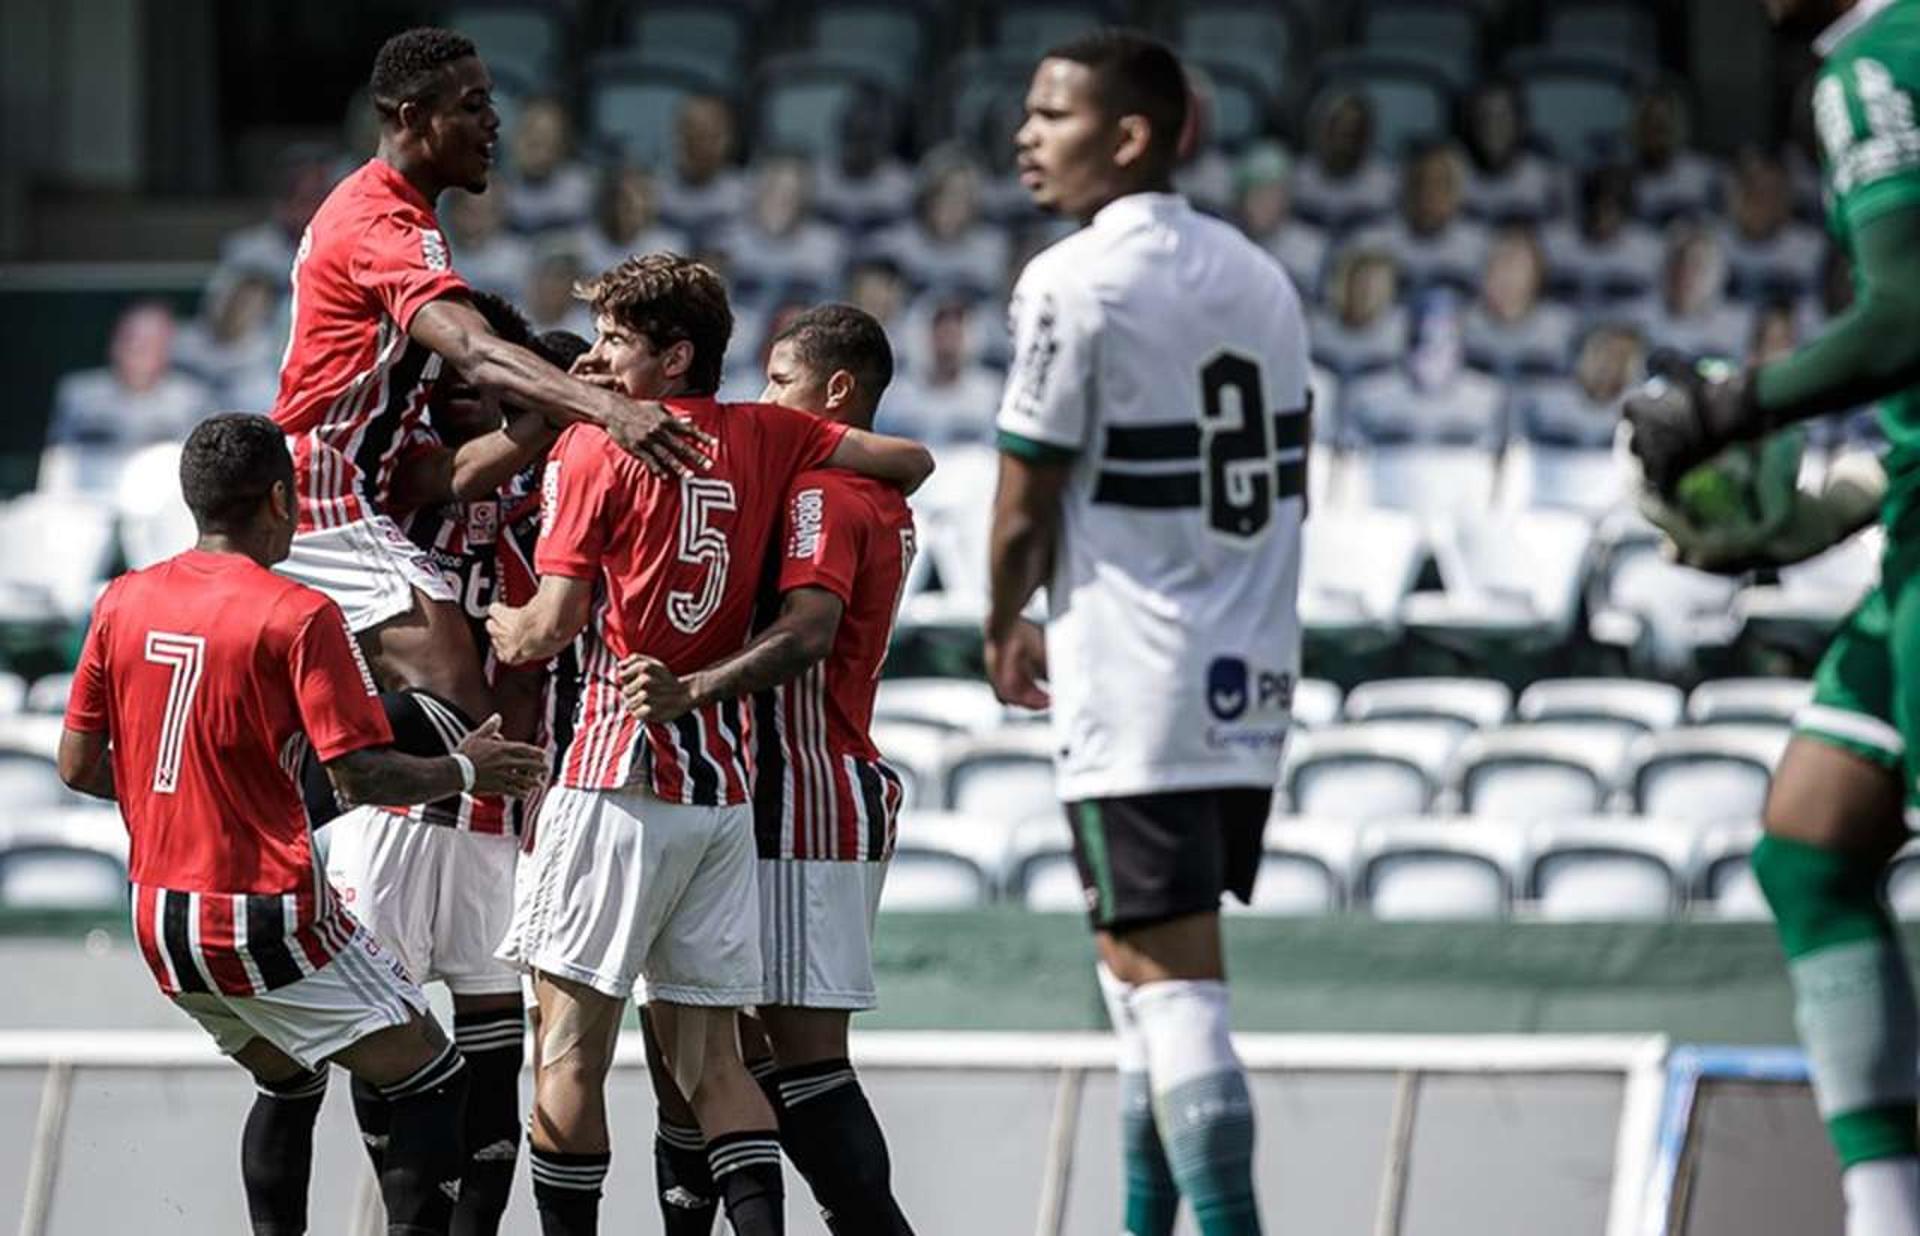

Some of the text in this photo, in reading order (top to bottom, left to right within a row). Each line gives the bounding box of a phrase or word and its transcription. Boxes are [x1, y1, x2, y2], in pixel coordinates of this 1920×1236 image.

[1199, 346, 1276, 545] 2
[666, 477, 736, 634] 5
[144, 629, 206, 794] 7
